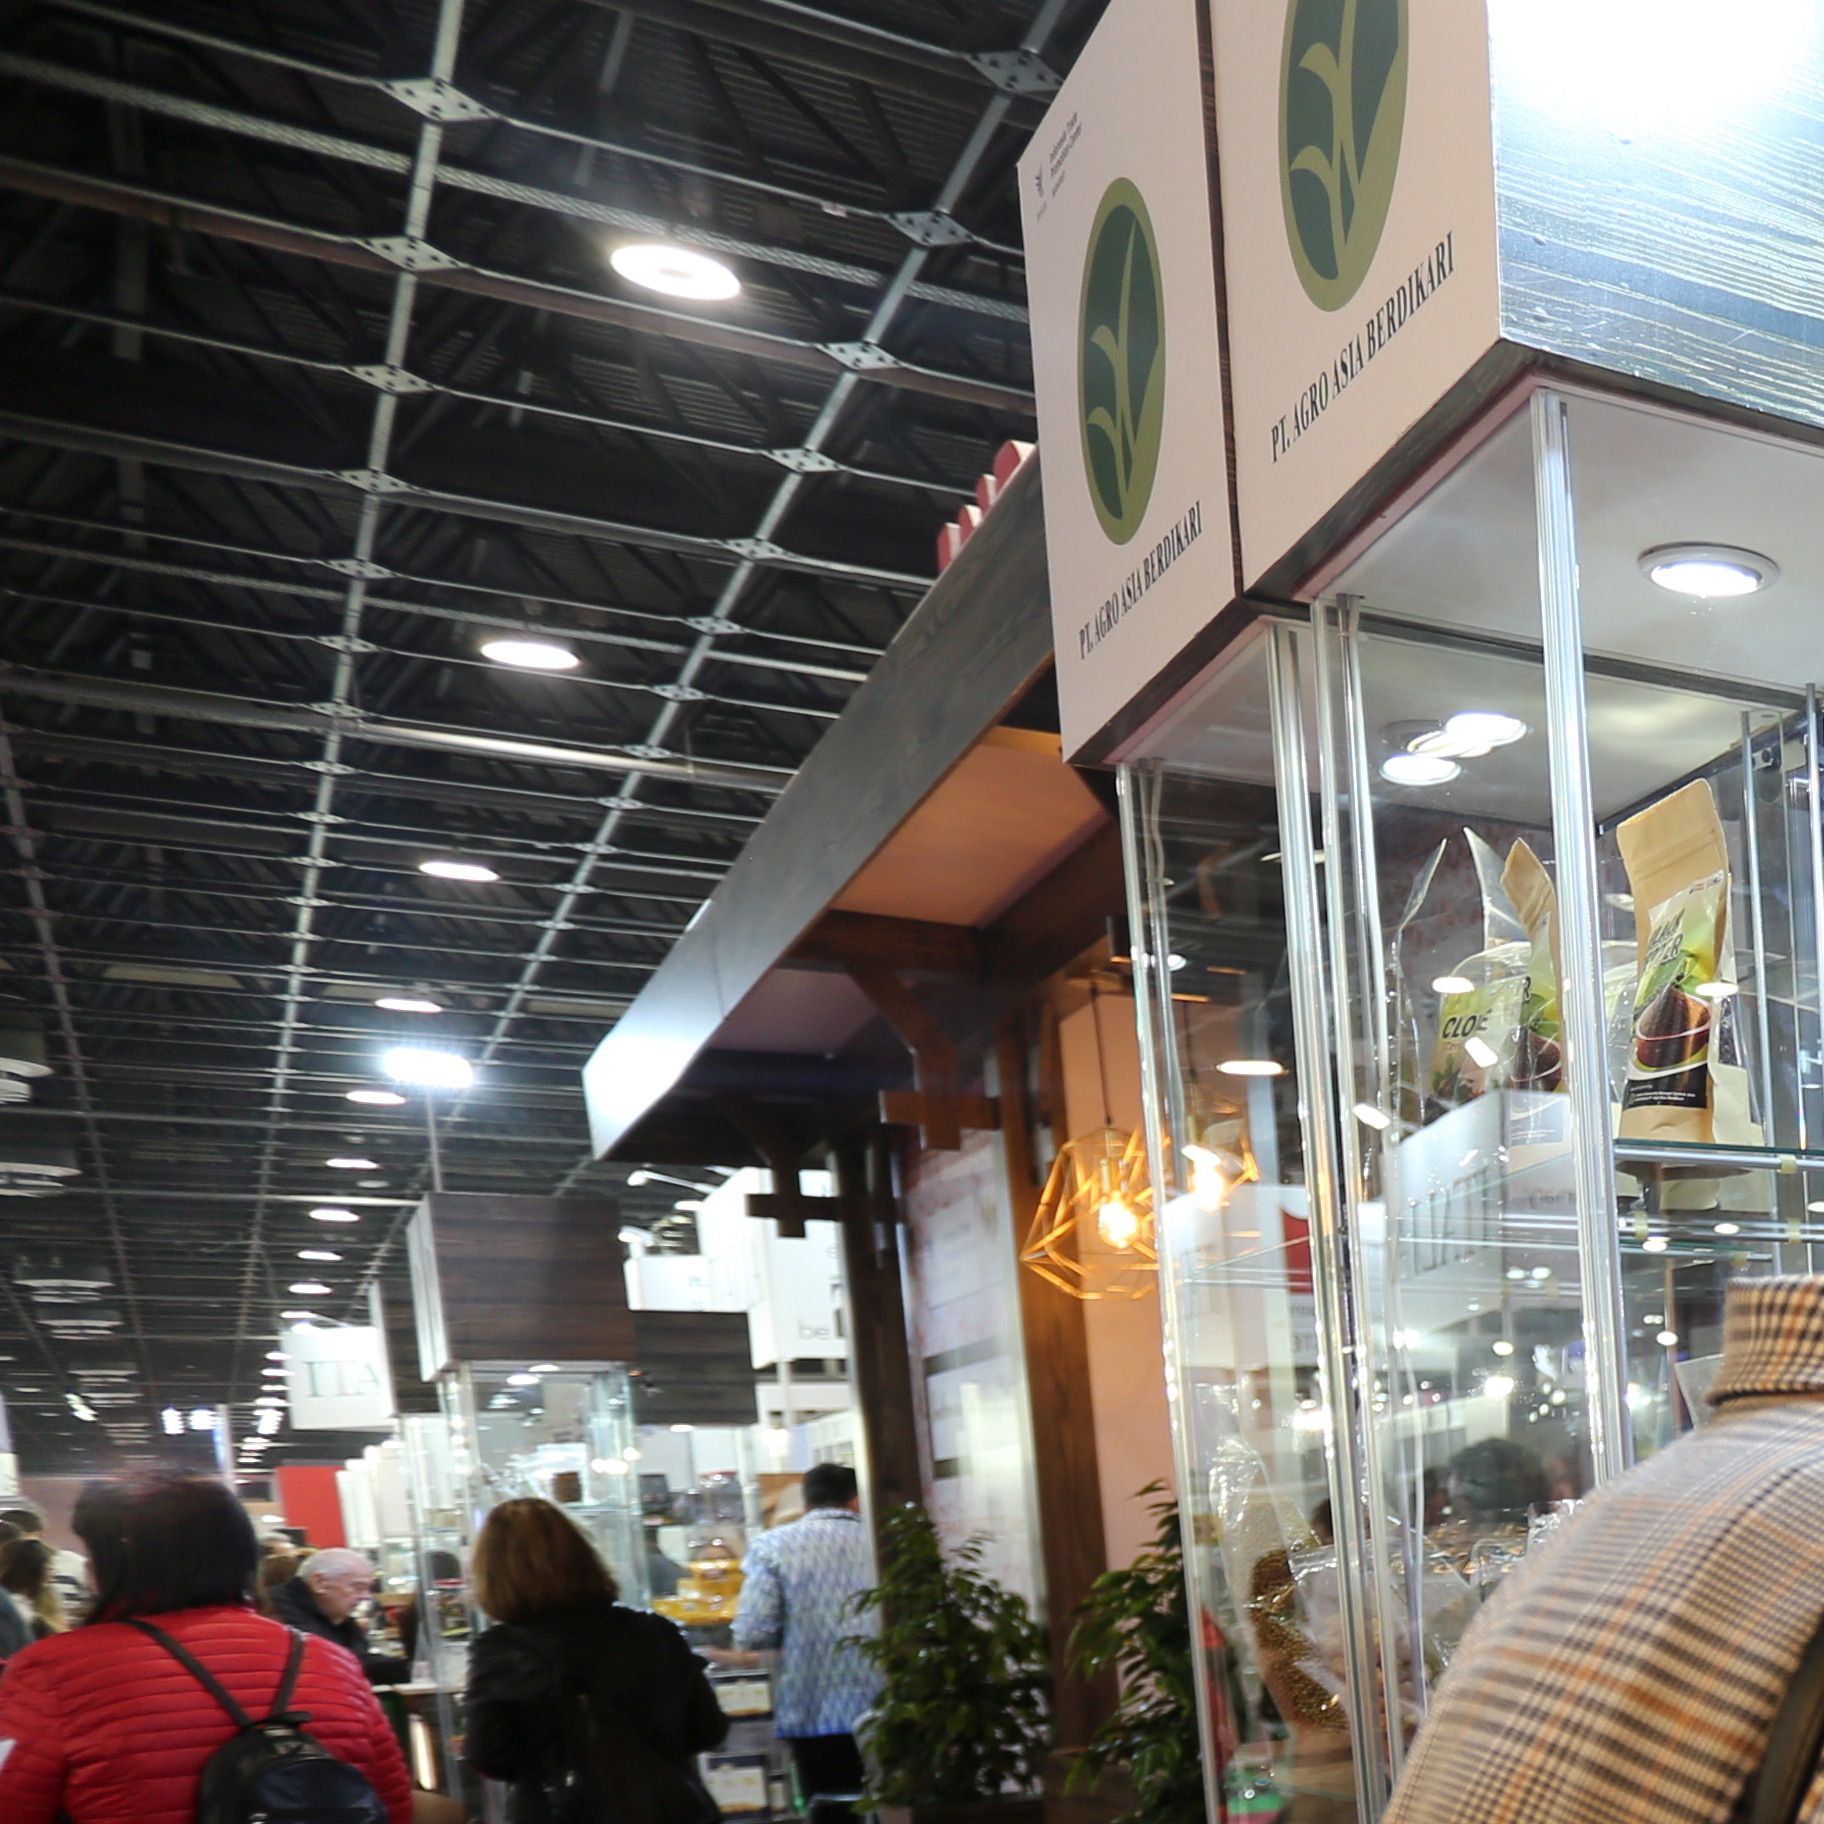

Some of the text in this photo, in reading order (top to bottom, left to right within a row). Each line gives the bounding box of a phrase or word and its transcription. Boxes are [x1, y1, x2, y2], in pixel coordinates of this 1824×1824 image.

[1271, 230, 1454, 463] PT. AGRO ASIA BERDIKARI
[1095, 592, 1120, 645] AGRO
[1121, 568, 1143, 617] ASIA
[1143, 500, 1202, 591] BERDIKARI
[1442, 1009, 1492, 1038] CLOE
